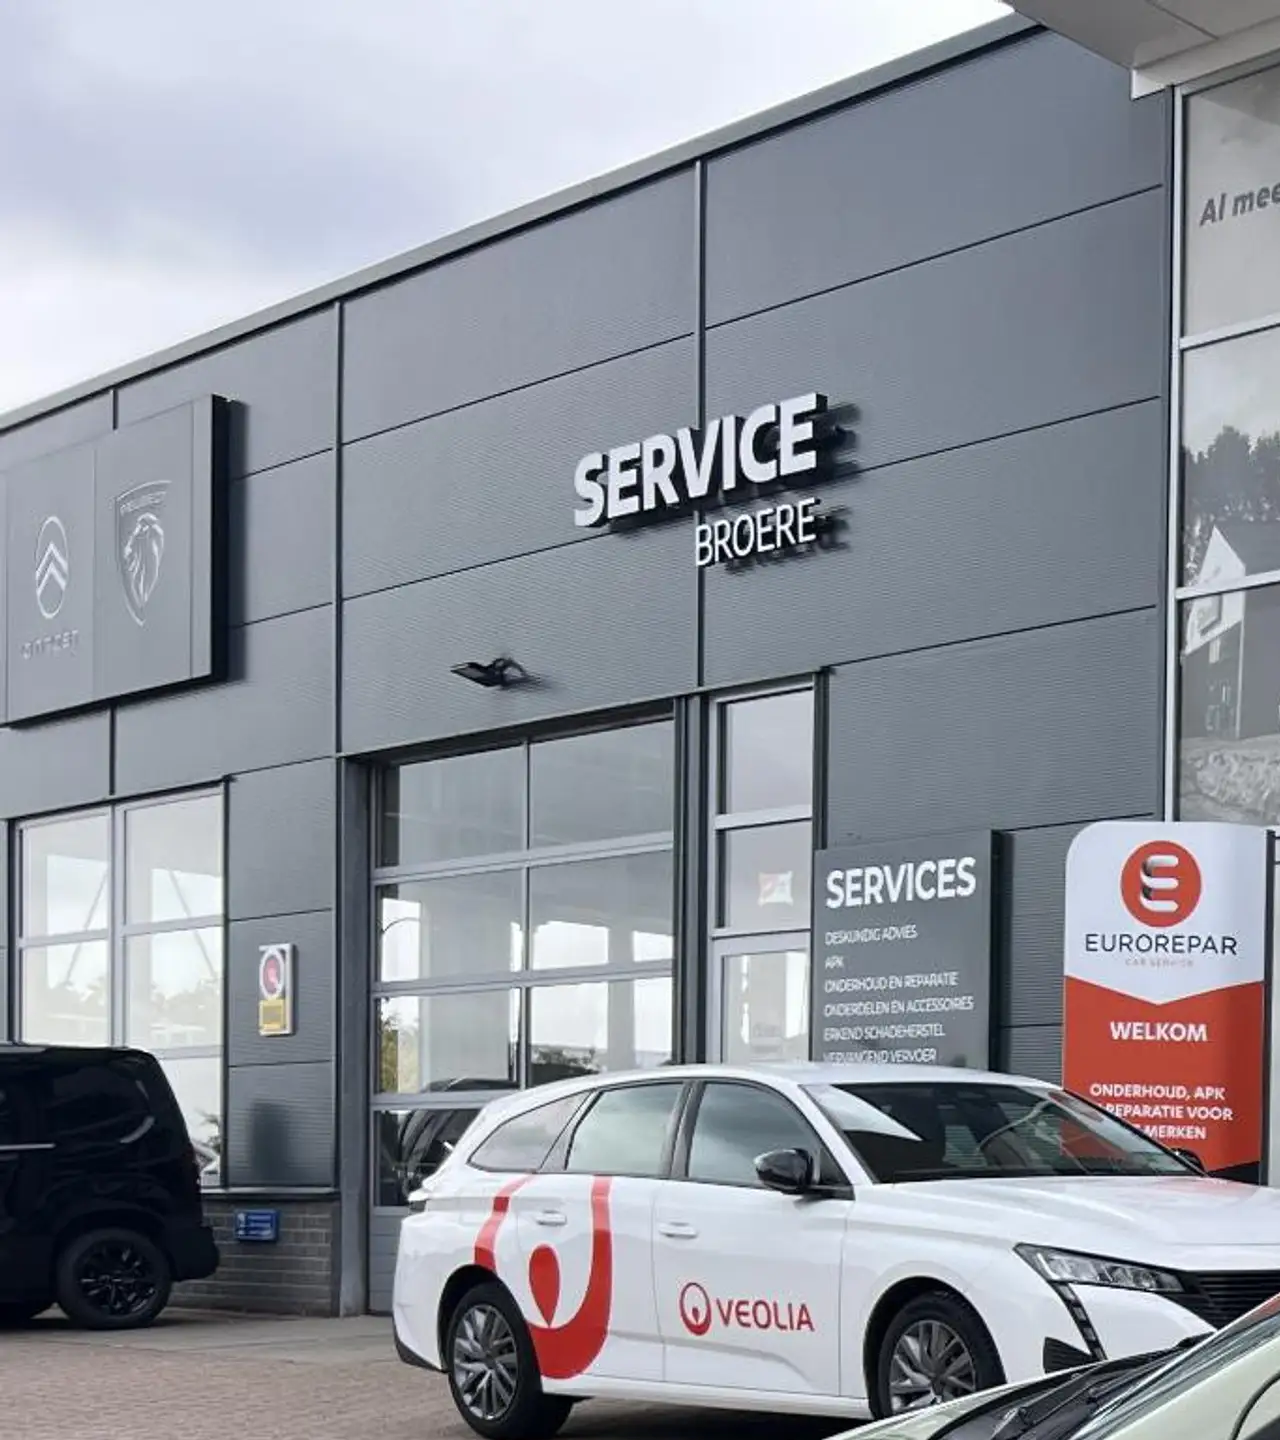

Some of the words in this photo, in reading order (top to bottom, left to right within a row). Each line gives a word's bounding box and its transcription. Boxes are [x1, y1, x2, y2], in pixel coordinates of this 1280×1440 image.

[1200, 193, 1226, 226] Al
[574, 392, 820, 526] SERVICE
[695, 497, 816, 566] BROERE
[825, 857, 977, 909] SERVICES
[1085, 934, 1238, 955] EUROREPAR
[1110, 1021, 1208, 1042] WELKOM
[1090, 1083, 1190, 1100] ONDERHOUD,
[1195, 1086, 1226, 1100] APK
[1106, 1104, 1184, 1119] REPARATIE
[1187, 1106, 1233, 1121] VOOR
[1144, 1124, 1207, 1140] MERKEN
[716, 1298, 815, 1333] VEOLIA
